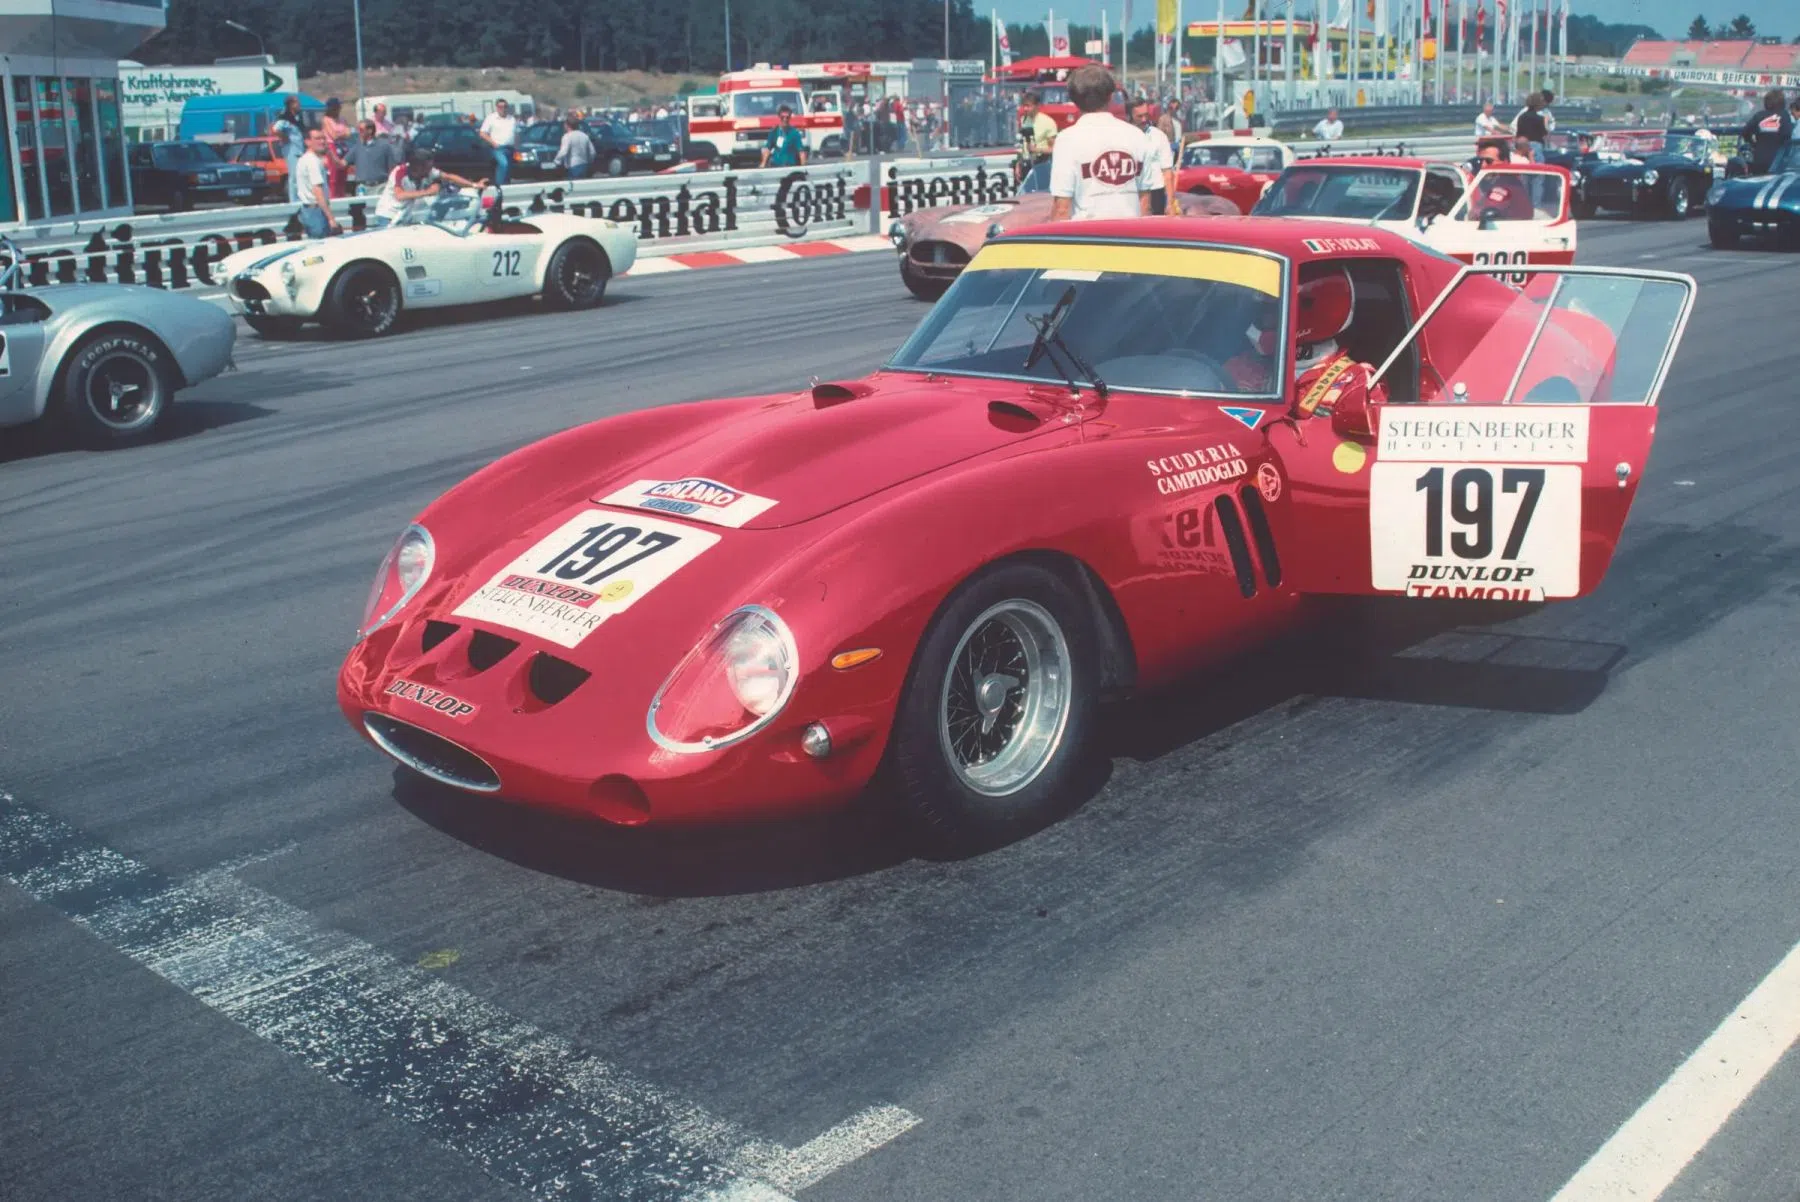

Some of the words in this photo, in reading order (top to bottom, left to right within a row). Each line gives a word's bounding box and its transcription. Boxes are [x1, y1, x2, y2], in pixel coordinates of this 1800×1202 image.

[1673, 70, 1719, 83] UNIROYAL
[1721, 72, 1757, 84] REIFEN
[493, 250, 521, 277] 212
[82, 338, 157, 369] GOODYEAR
[1387, 420, 1576, 439] STEIGENBERGER
[1147, 443, 1241, 476] SCUDERIA
[1157, 458, 1249, 495] CAMPIDOGLIO
[1416, 467, 1546, 561] 197
[537, 522, 682, 586] 197
[1407, 564, 1535, 583] DUNLOP
[505, 577, 594, 602] DUNLOP
[386, 680, 474, 717] DUNLOP
